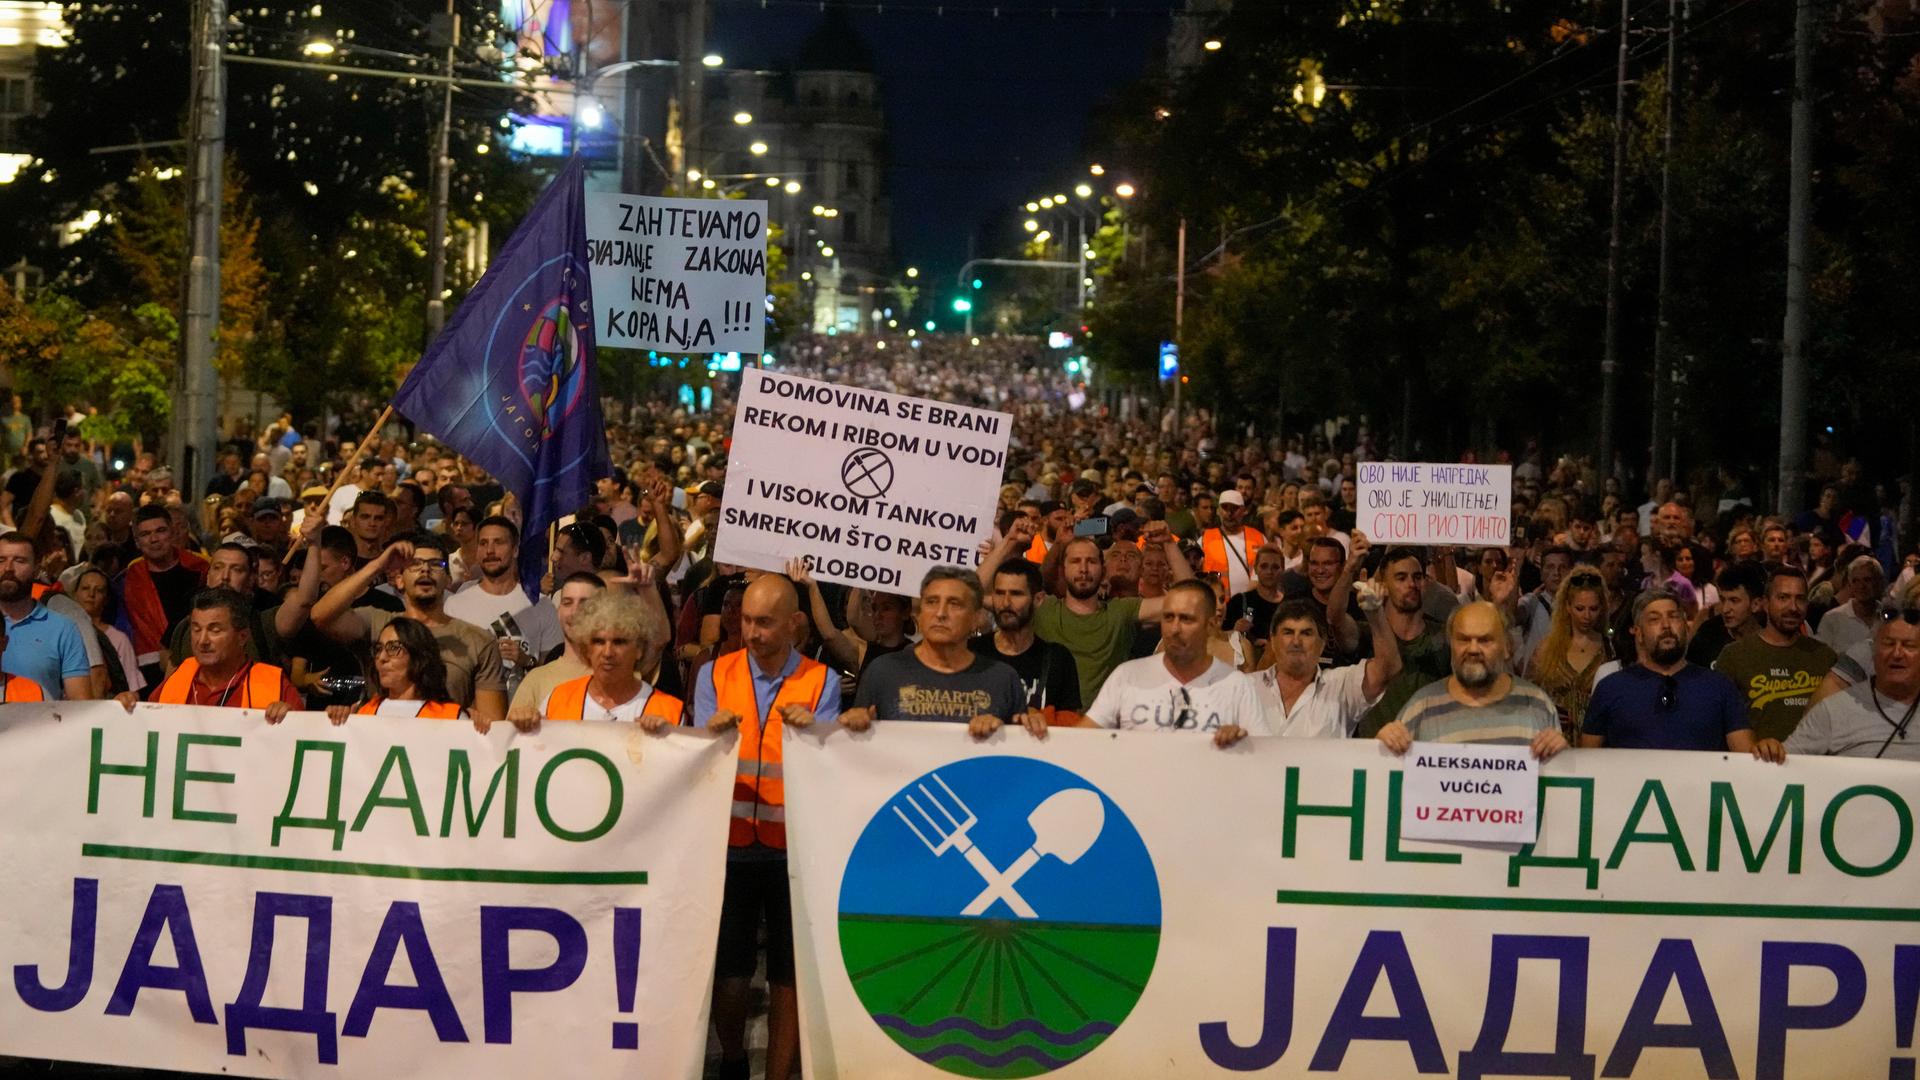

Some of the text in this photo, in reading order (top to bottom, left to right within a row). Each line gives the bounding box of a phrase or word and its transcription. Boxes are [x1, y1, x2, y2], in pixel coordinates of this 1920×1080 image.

[619, 203, 761, 241] ZAHTEVAMO
[684, 246, 766, 276] ZAKONA
[631, 276, 690, 310] NEMA
[759, 377, 1000, 435] DOMOVINA SE BRANI
[744, 406, 1004, 468] REKOM I RIBOM U VODI
[1359, 465, 1492, 485] ОВО НИЈЕ НАПРЕДАК
[746, 478, 978, 534] I VISOKOM TANKOM
[1368, 490, 1498, 510] ОВО ЈЕ УНИШТЕЊЕ!
[725, 507, 842, 544] SMREKOM
[846, 524, 892, 550] ŠTO
[897, 538, 969, 565] RASTE
[1373, 512, 1508, 540] СТОП РИО ТИНТО
[803, 554, 902, 587] SLOBODI
[1770, 668, 1790, 677] REAL
[915, 689, 974, 704] SMART
[1131, 704, 1221, 731] CUBA
[1416, 756, 1527, 771] ALEKSANDRA
[87, 728, 624, 850] НЕ ДАМО
[1440, 779, 1502, 795] VUČIĆA
[1416, 806, 1524, 824] U ZATVOR!
[1507, 776, 1914, 890] ДАМО
[13, 877, 642, 1065] ЈАДАР!
[1198, 926, 1920, 1080] ЈАДАР!
